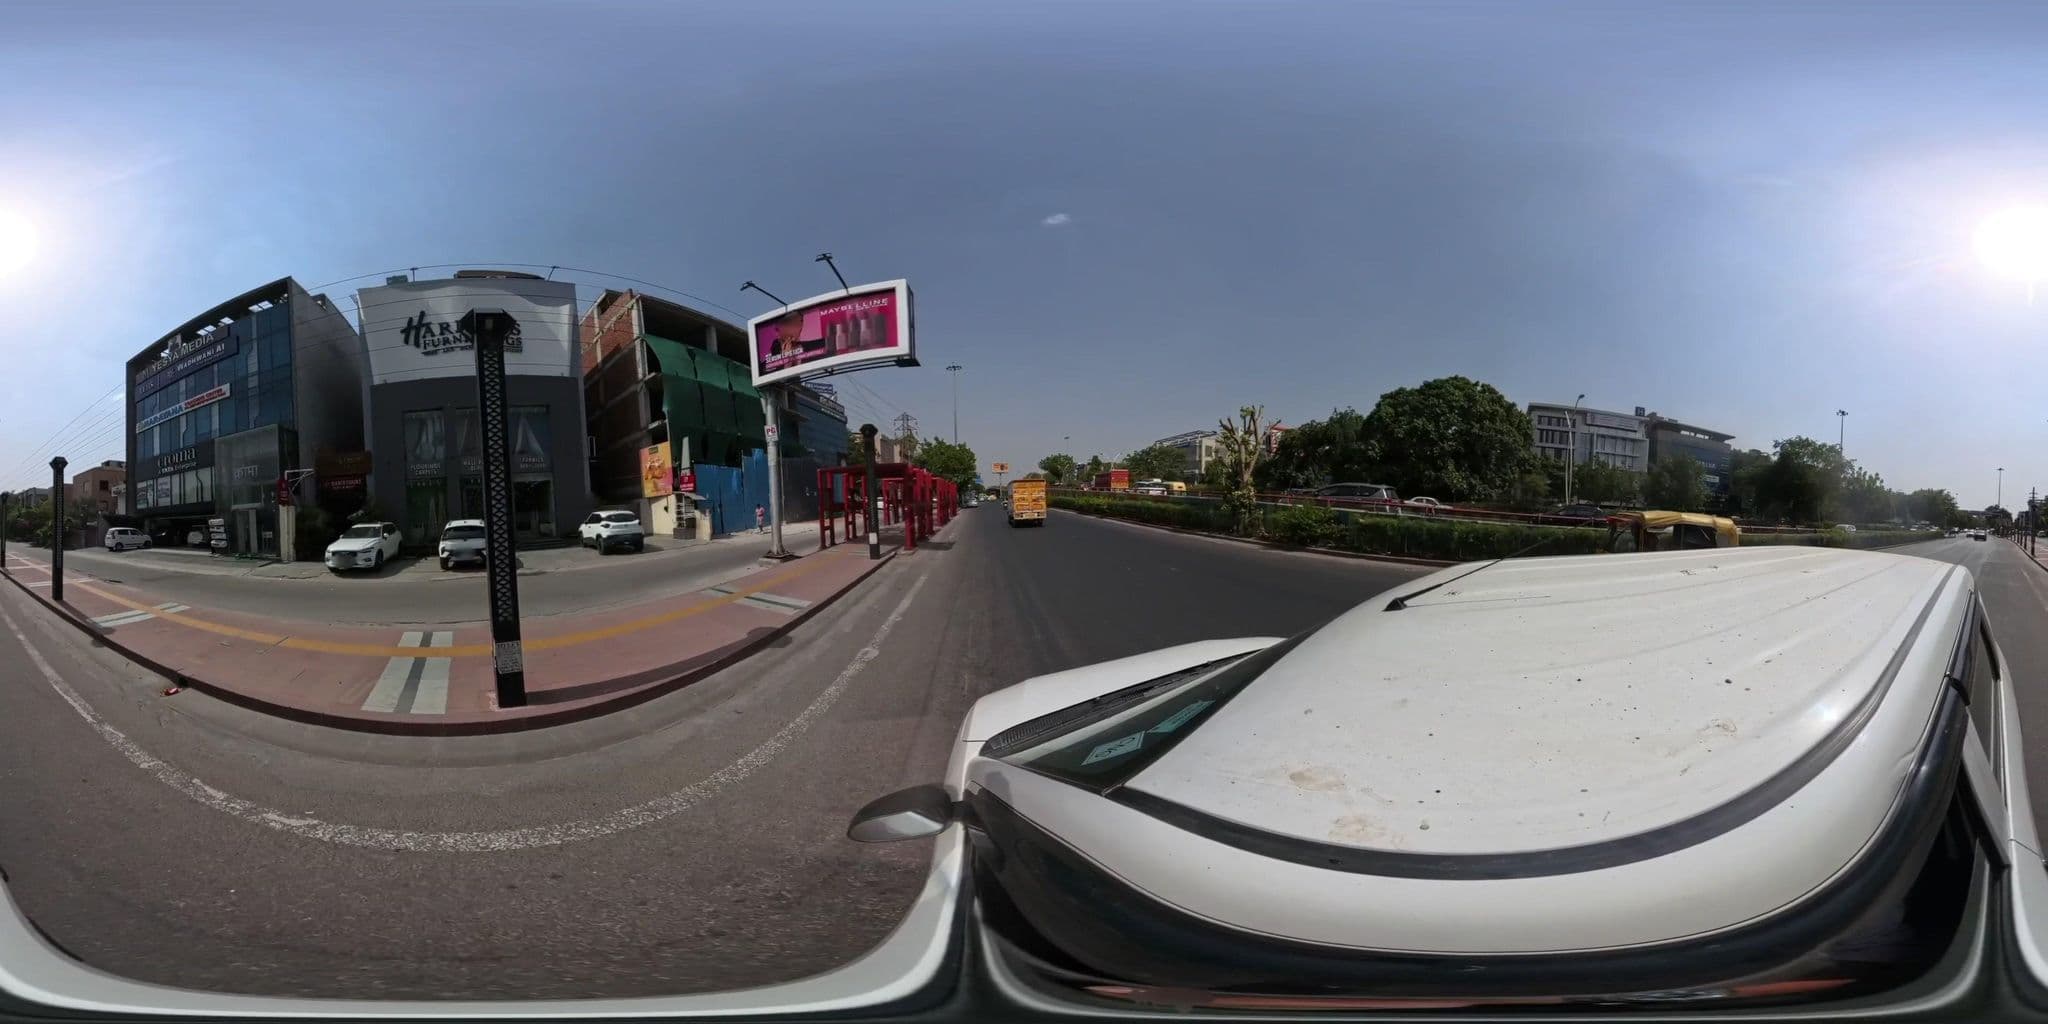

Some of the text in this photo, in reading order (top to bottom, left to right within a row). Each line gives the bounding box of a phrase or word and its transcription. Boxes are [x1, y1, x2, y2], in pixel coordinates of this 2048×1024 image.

[820, 298, 888, 315] MAYBELLINE
[180, 333, 214, 356] MEDIA
[158, 447, 196, 467] croma
